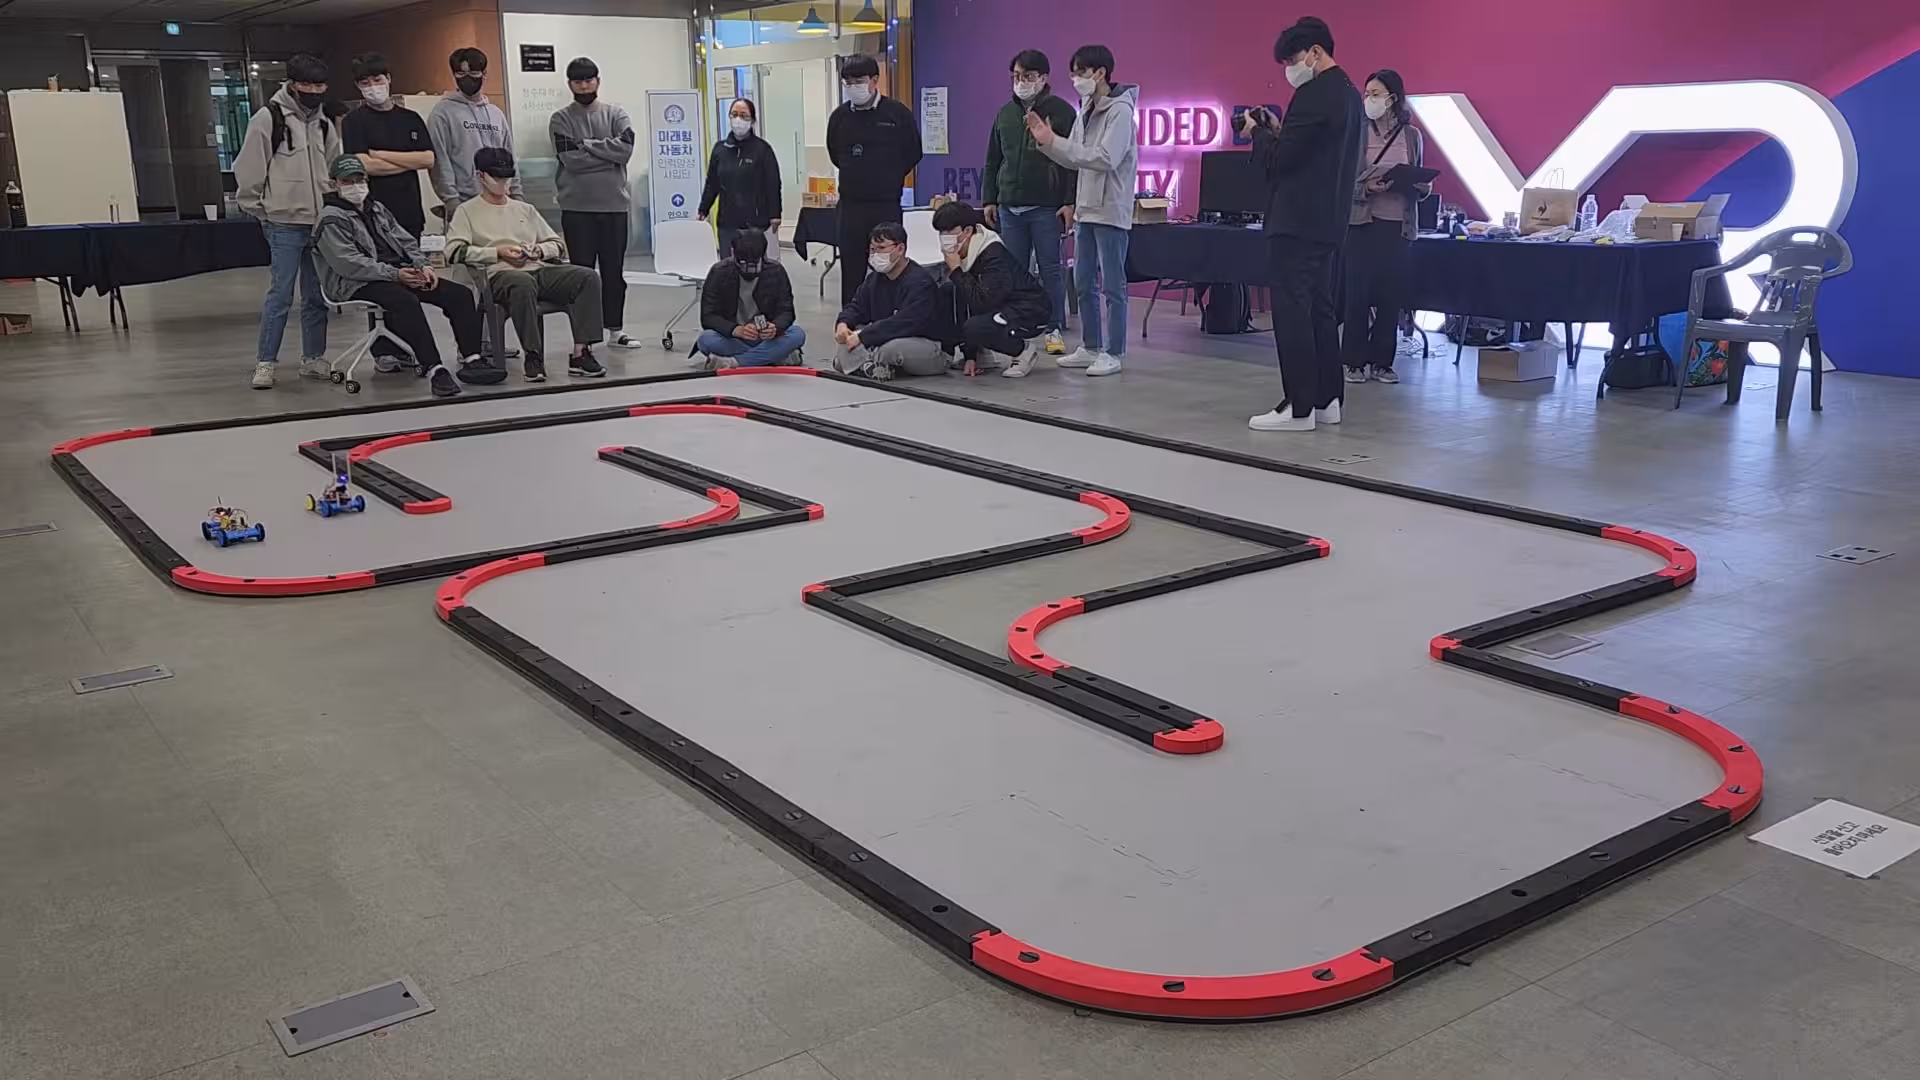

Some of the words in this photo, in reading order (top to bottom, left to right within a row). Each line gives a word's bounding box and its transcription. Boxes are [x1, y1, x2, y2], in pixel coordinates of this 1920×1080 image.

[658, 130, 692, 142] 미래형
[659, 144, 693, 156] 자동차
[944, 168, 984, 200] BEY
[1134, 170, 1174, 197] TY
[1811, 829, 1844, 845] 신발을
[1836, 821, 1860, 833] 신고
[1823, 835, 1866, 857] 들어오지
[1855, 823, 1889, 839] 마세요
